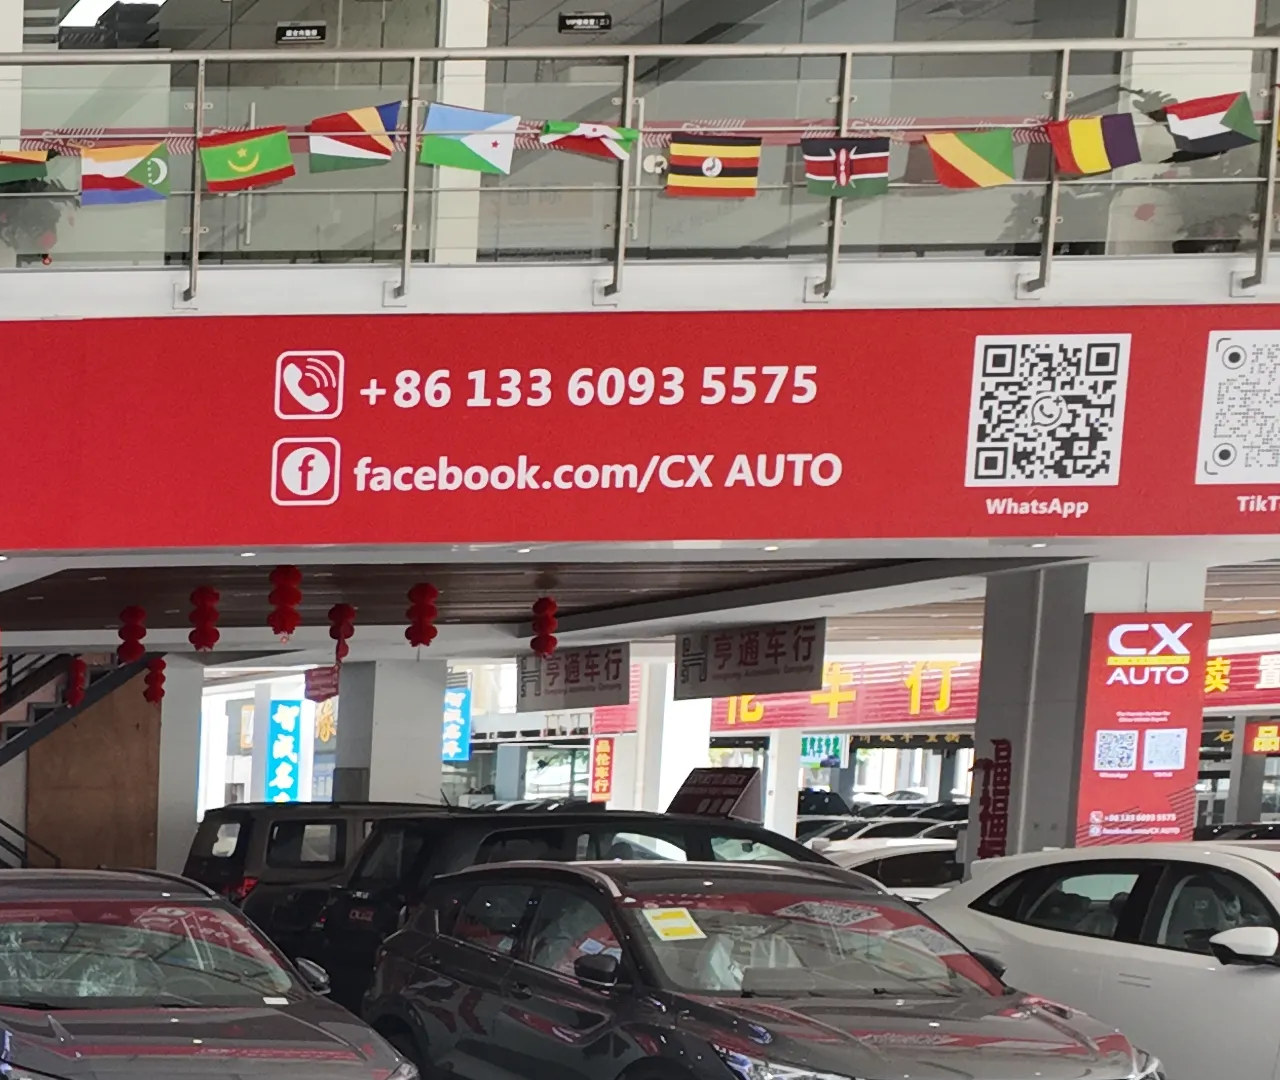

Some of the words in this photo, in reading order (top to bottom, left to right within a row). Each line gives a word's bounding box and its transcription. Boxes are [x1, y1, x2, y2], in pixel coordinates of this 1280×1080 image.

[360, 370, 451, 408] +86
[467, 369, 551, 406] 133
[568, 367, 684, 406] 6093
[701, 366, 816, 404] 5575
[354, 455, 713, 492] facebook.com/CX
[725, 453, 842, 487] AUTO
[986, 498, 1088, 518] WhatsApp
[1237, 495, 1280, 512] TikT
[713, 624, 816, 670] 亨通车行
[1108, 622, 1192, 656] CX
[1106, 667, 1189, 685] AUTO
